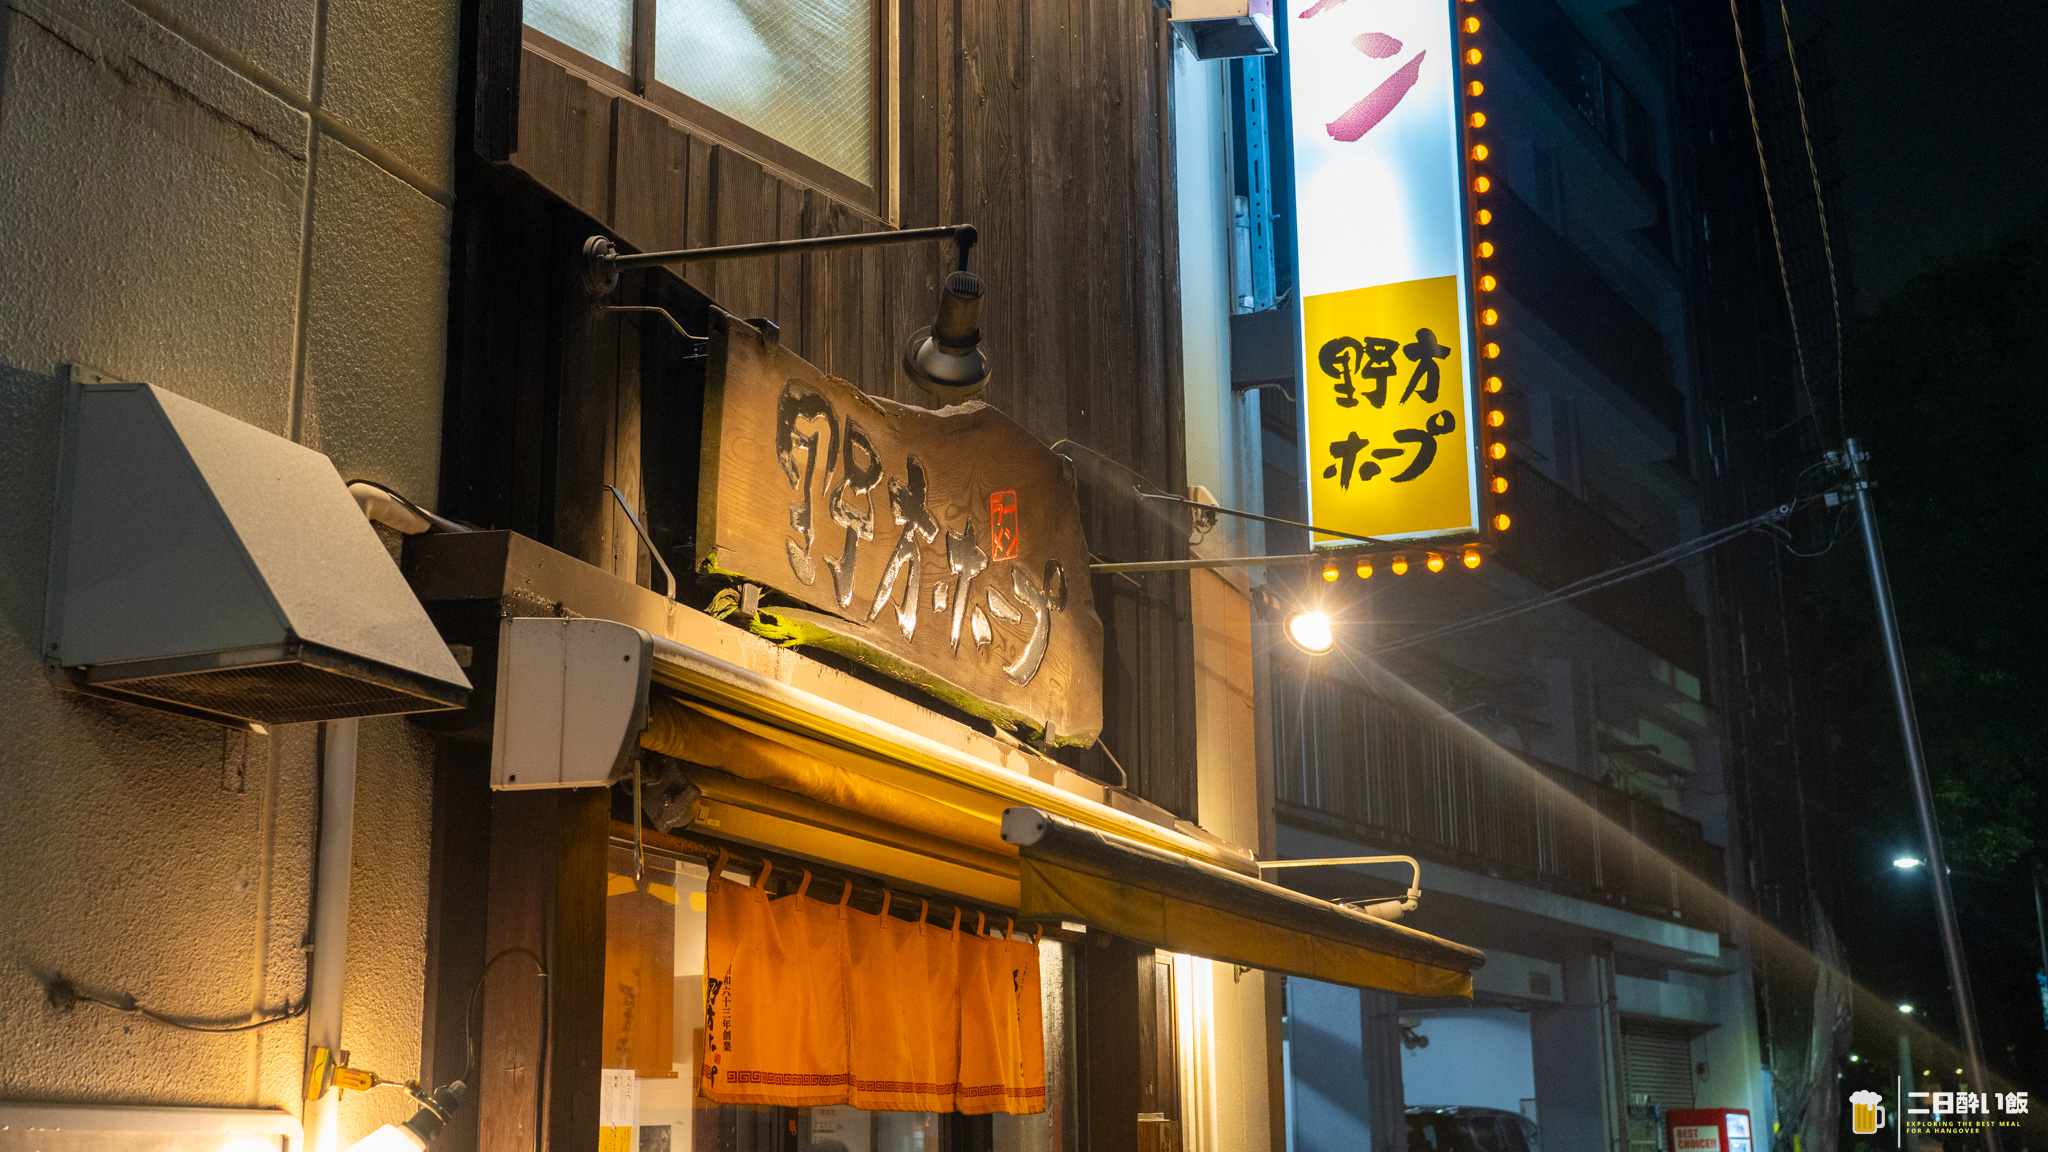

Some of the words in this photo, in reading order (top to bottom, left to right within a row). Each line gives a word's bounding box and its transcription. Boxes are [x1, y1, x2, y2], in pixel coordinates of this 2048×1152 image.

[1298, 0, 1427, 143] ン
[1318, 327, 1451, 410] 野方
[1323, 409, 1456, 494] ホープ
[775, 379, 1067, 687] 野方ホープ
[1676, 1128, 1699, 1139] BEST
